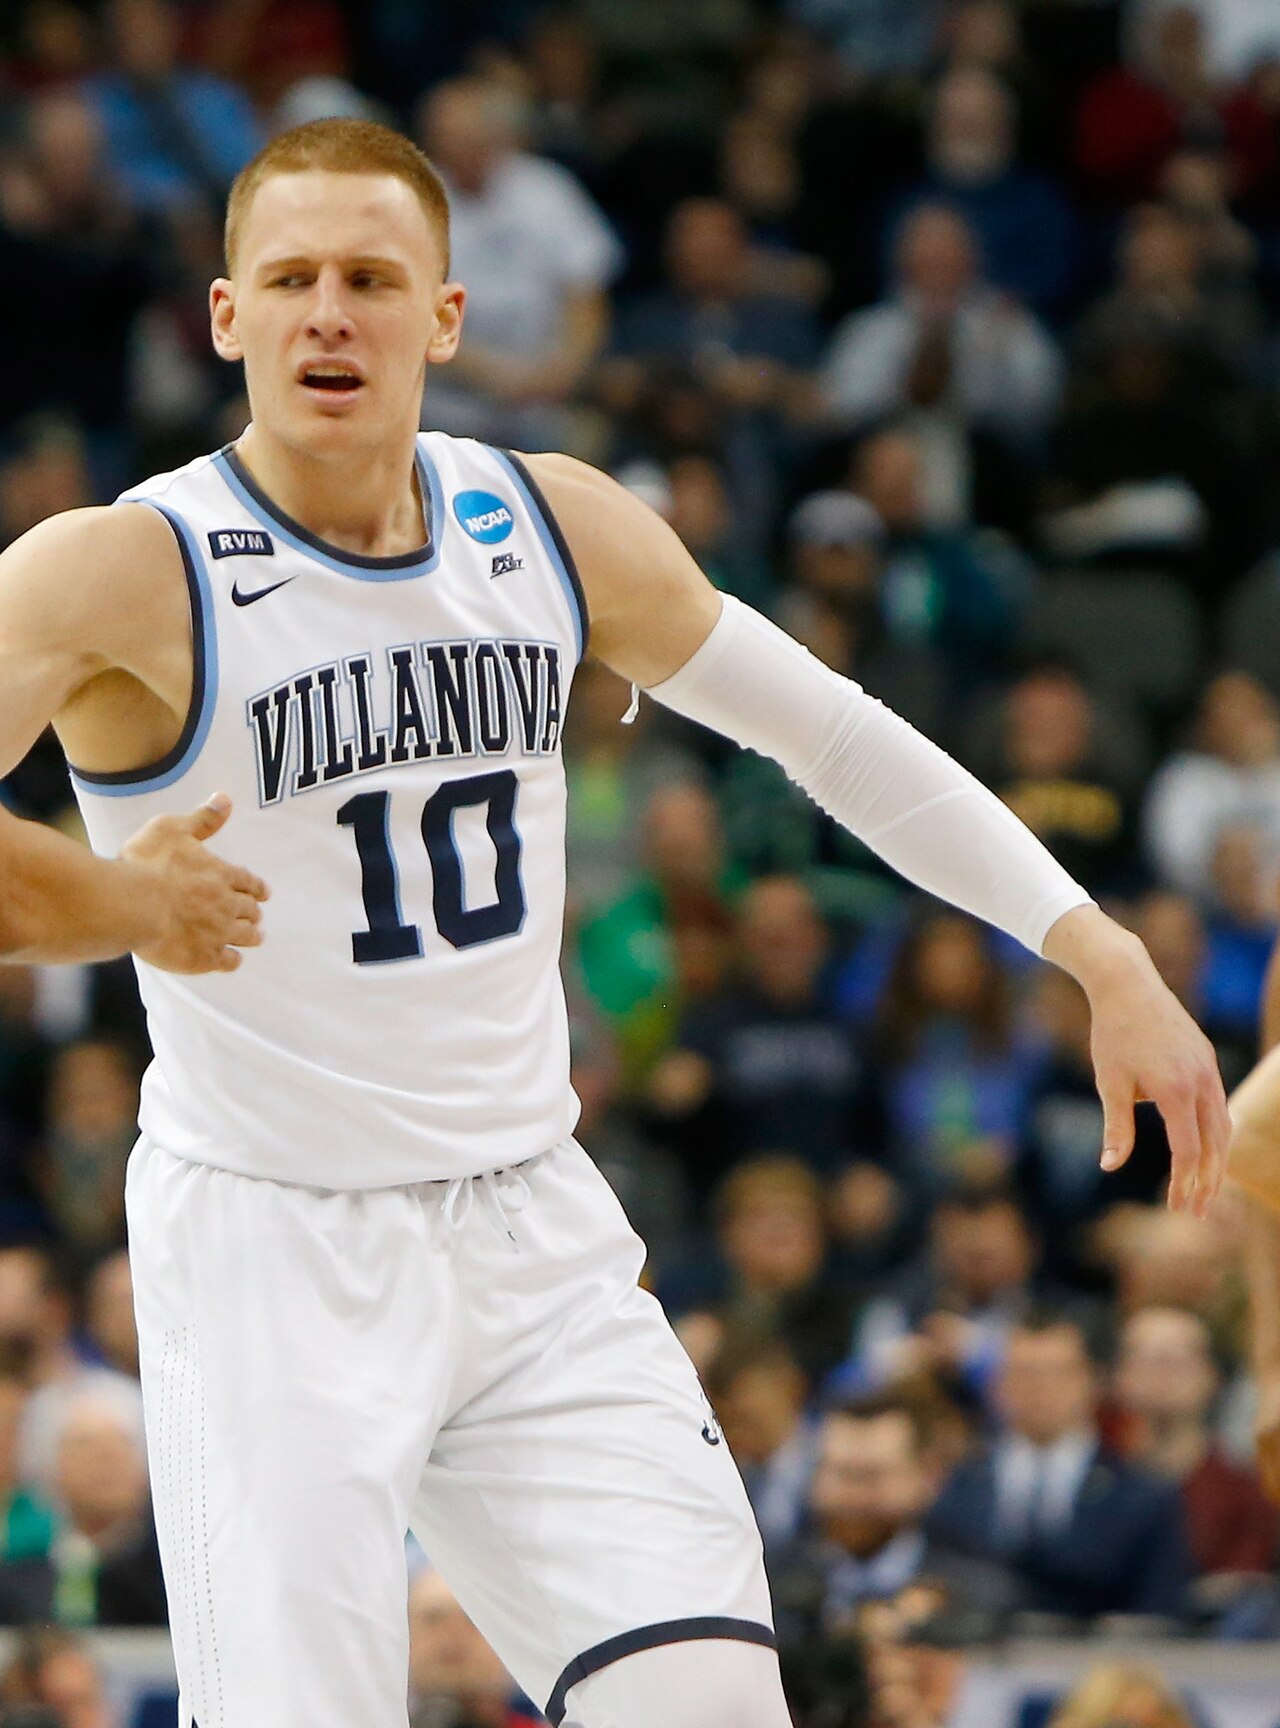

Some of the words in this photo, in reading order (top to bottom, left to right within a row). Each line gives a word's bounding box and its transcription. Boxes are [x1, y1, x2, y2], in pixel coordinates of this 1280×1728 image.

[218, 533, 265, 551] RVM
[465, 507, 512, 533] NCAA
[246, 638, 563, 808] VILLANOVA
[336, 769, 528, 966] 10
